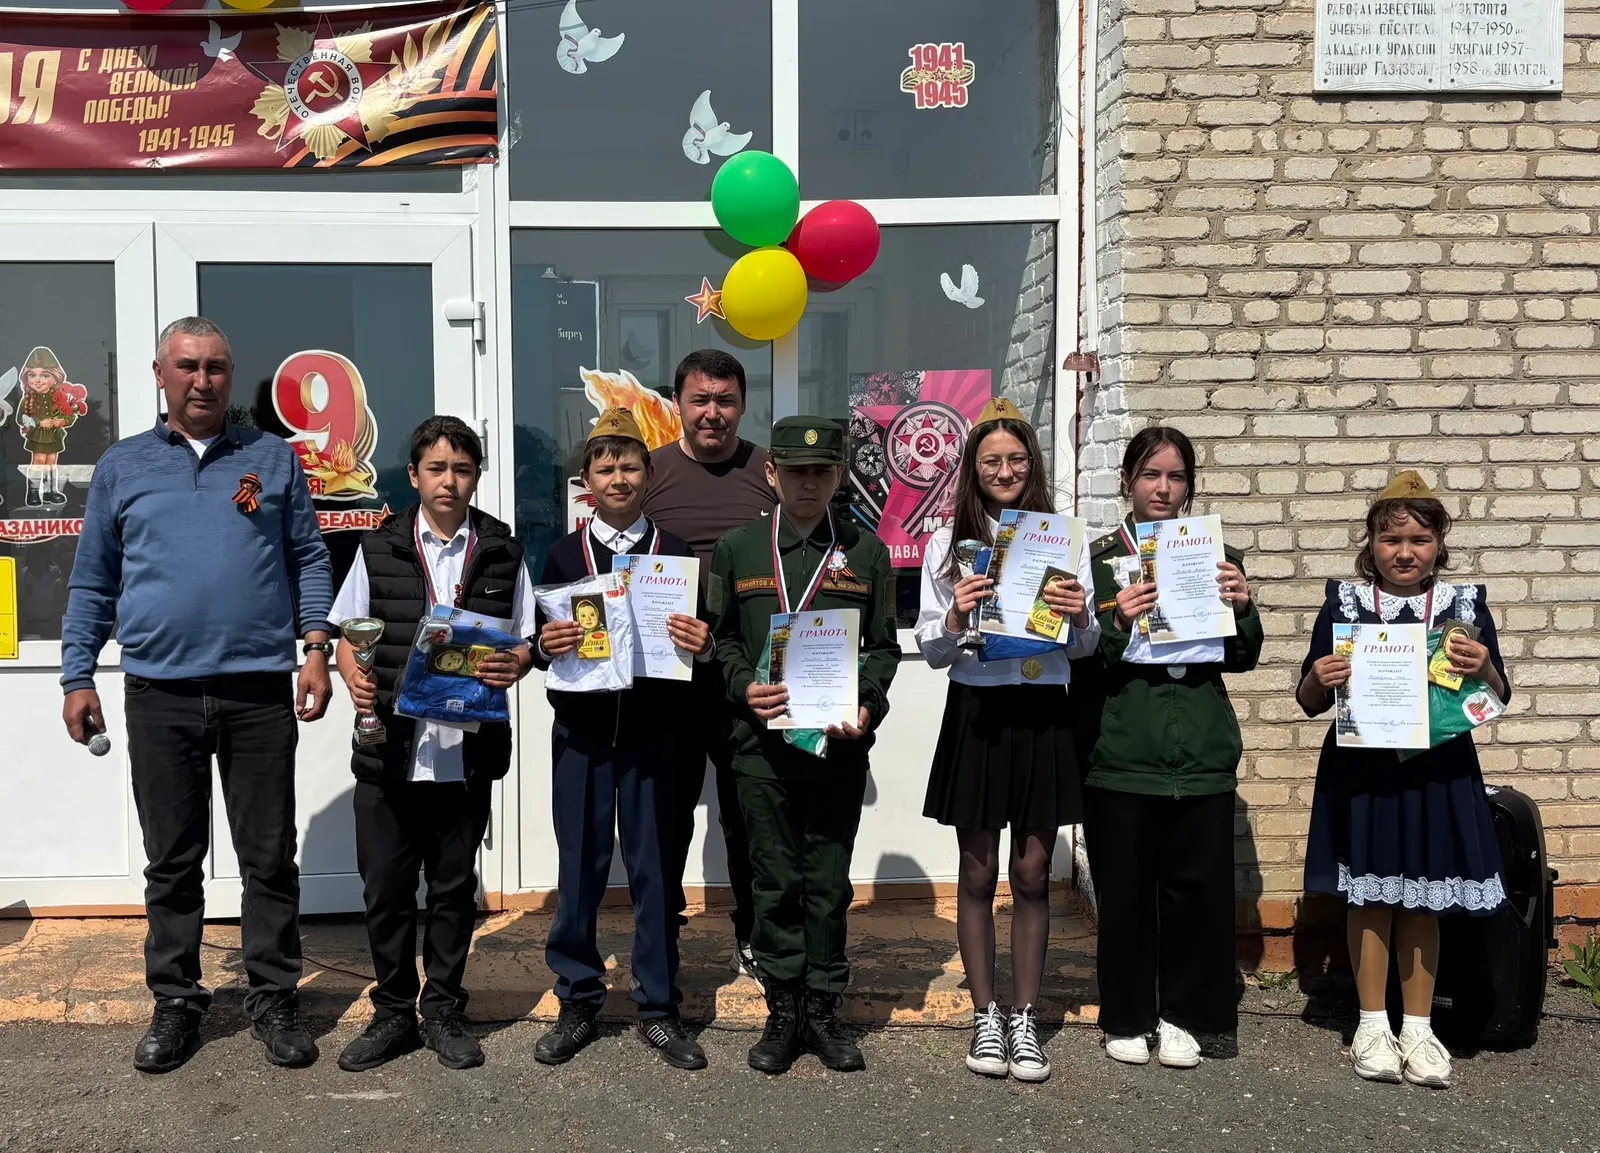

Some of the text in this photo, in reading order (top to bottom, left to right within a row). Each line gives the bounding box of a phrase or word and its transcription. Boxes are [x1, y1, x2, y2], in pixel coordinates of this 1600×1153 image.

[1450, 21, 1514, 36] 1947-1950
[77, 48, 89, 72] С
[910, 43, 963, 71] 1941
[109, 62, 198, 95] ВЕЛИКОЙ
[914, 81, 968, 109] 1945
[84, 94, 171, 125] ПОБЕДЫ!
[139, 123, 236, 153] 1941-1945
[276, 350, 362, 470] 9
[317, 512, 373, 528] БЕДЫ
[1022, 532, 1072, 547] ГРАМОТА
[1166, 536, 1213, 549] ГРАМОТА
[889, 544, 920, 559] ЛАВА
[639, 575, 688, 587] ГРАМОТА
[799, 628, 848, 638] ГРАМОТА
[1363, 644, 1415, 653] ГРАМОТА
